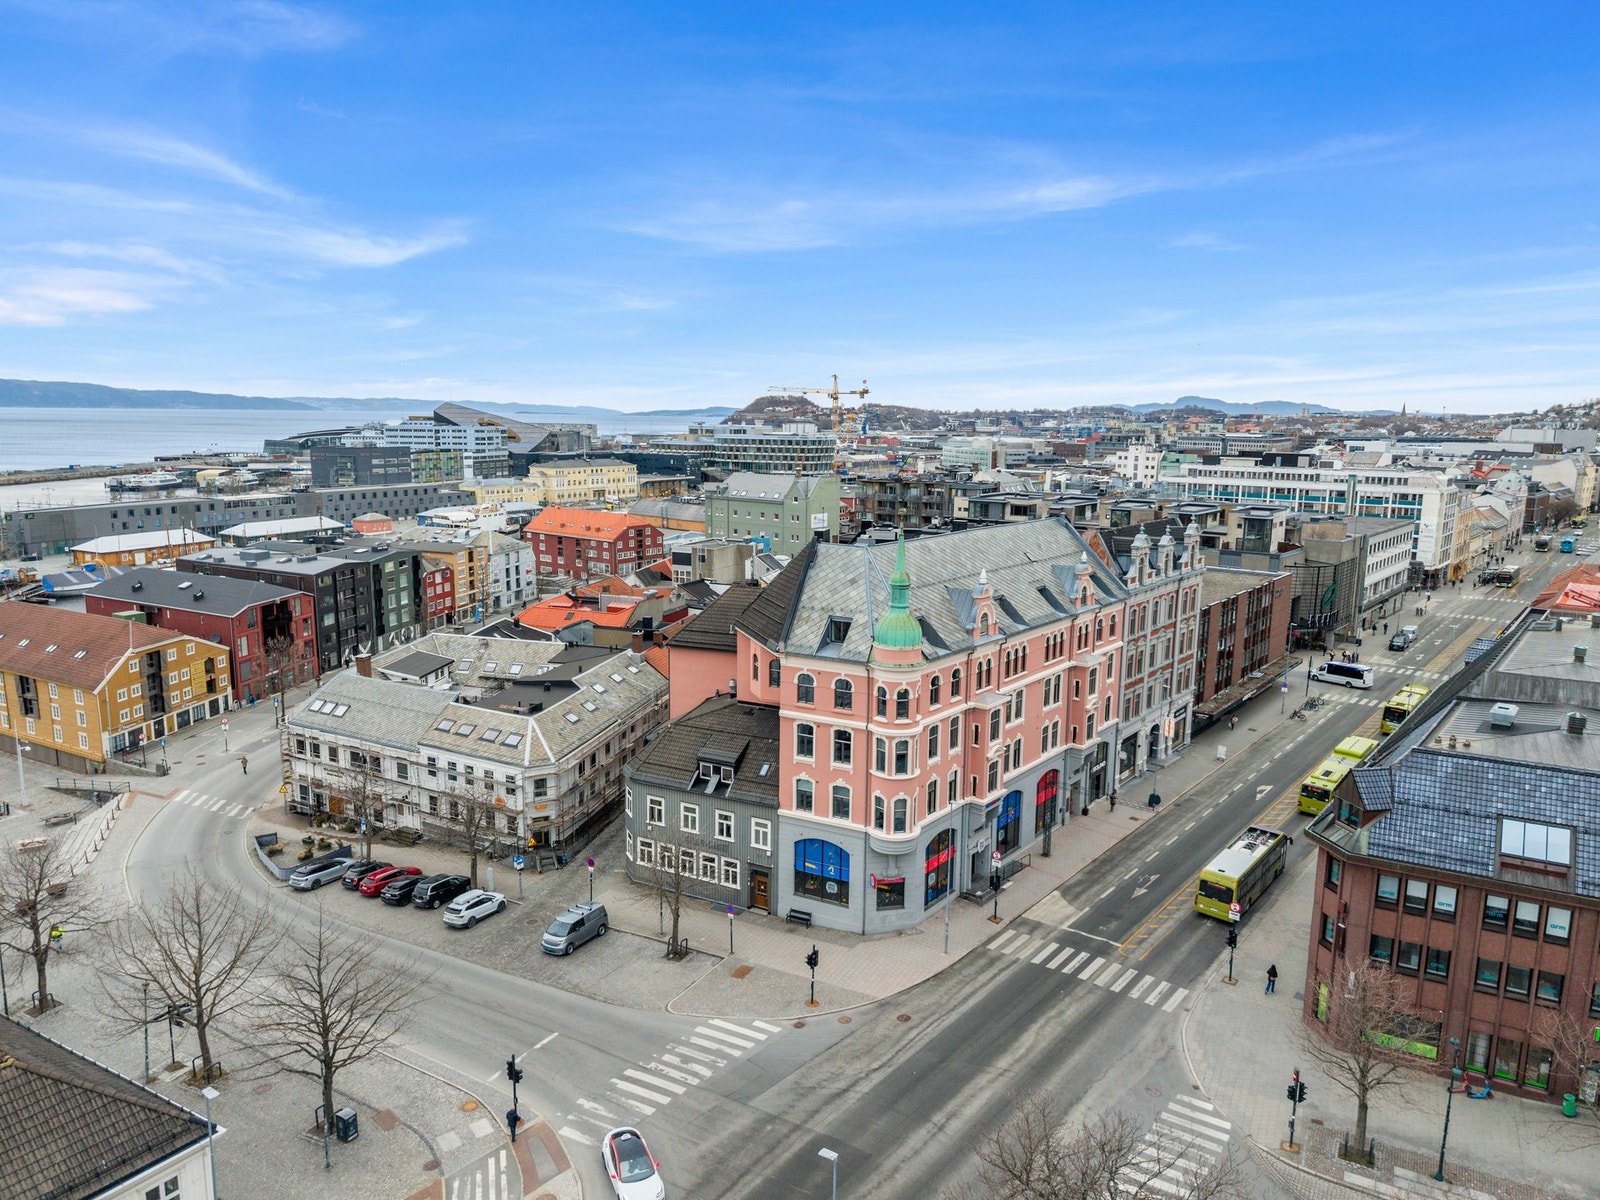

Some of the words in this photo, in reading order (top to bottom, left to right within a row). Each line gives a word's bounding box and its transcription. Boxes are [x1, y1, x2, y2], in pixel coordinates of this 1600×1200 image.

[1380, 889, 1395, 897] arm
[1550, 923, 1566, 931] arm
[1430, 961, 1445, 969] arm
